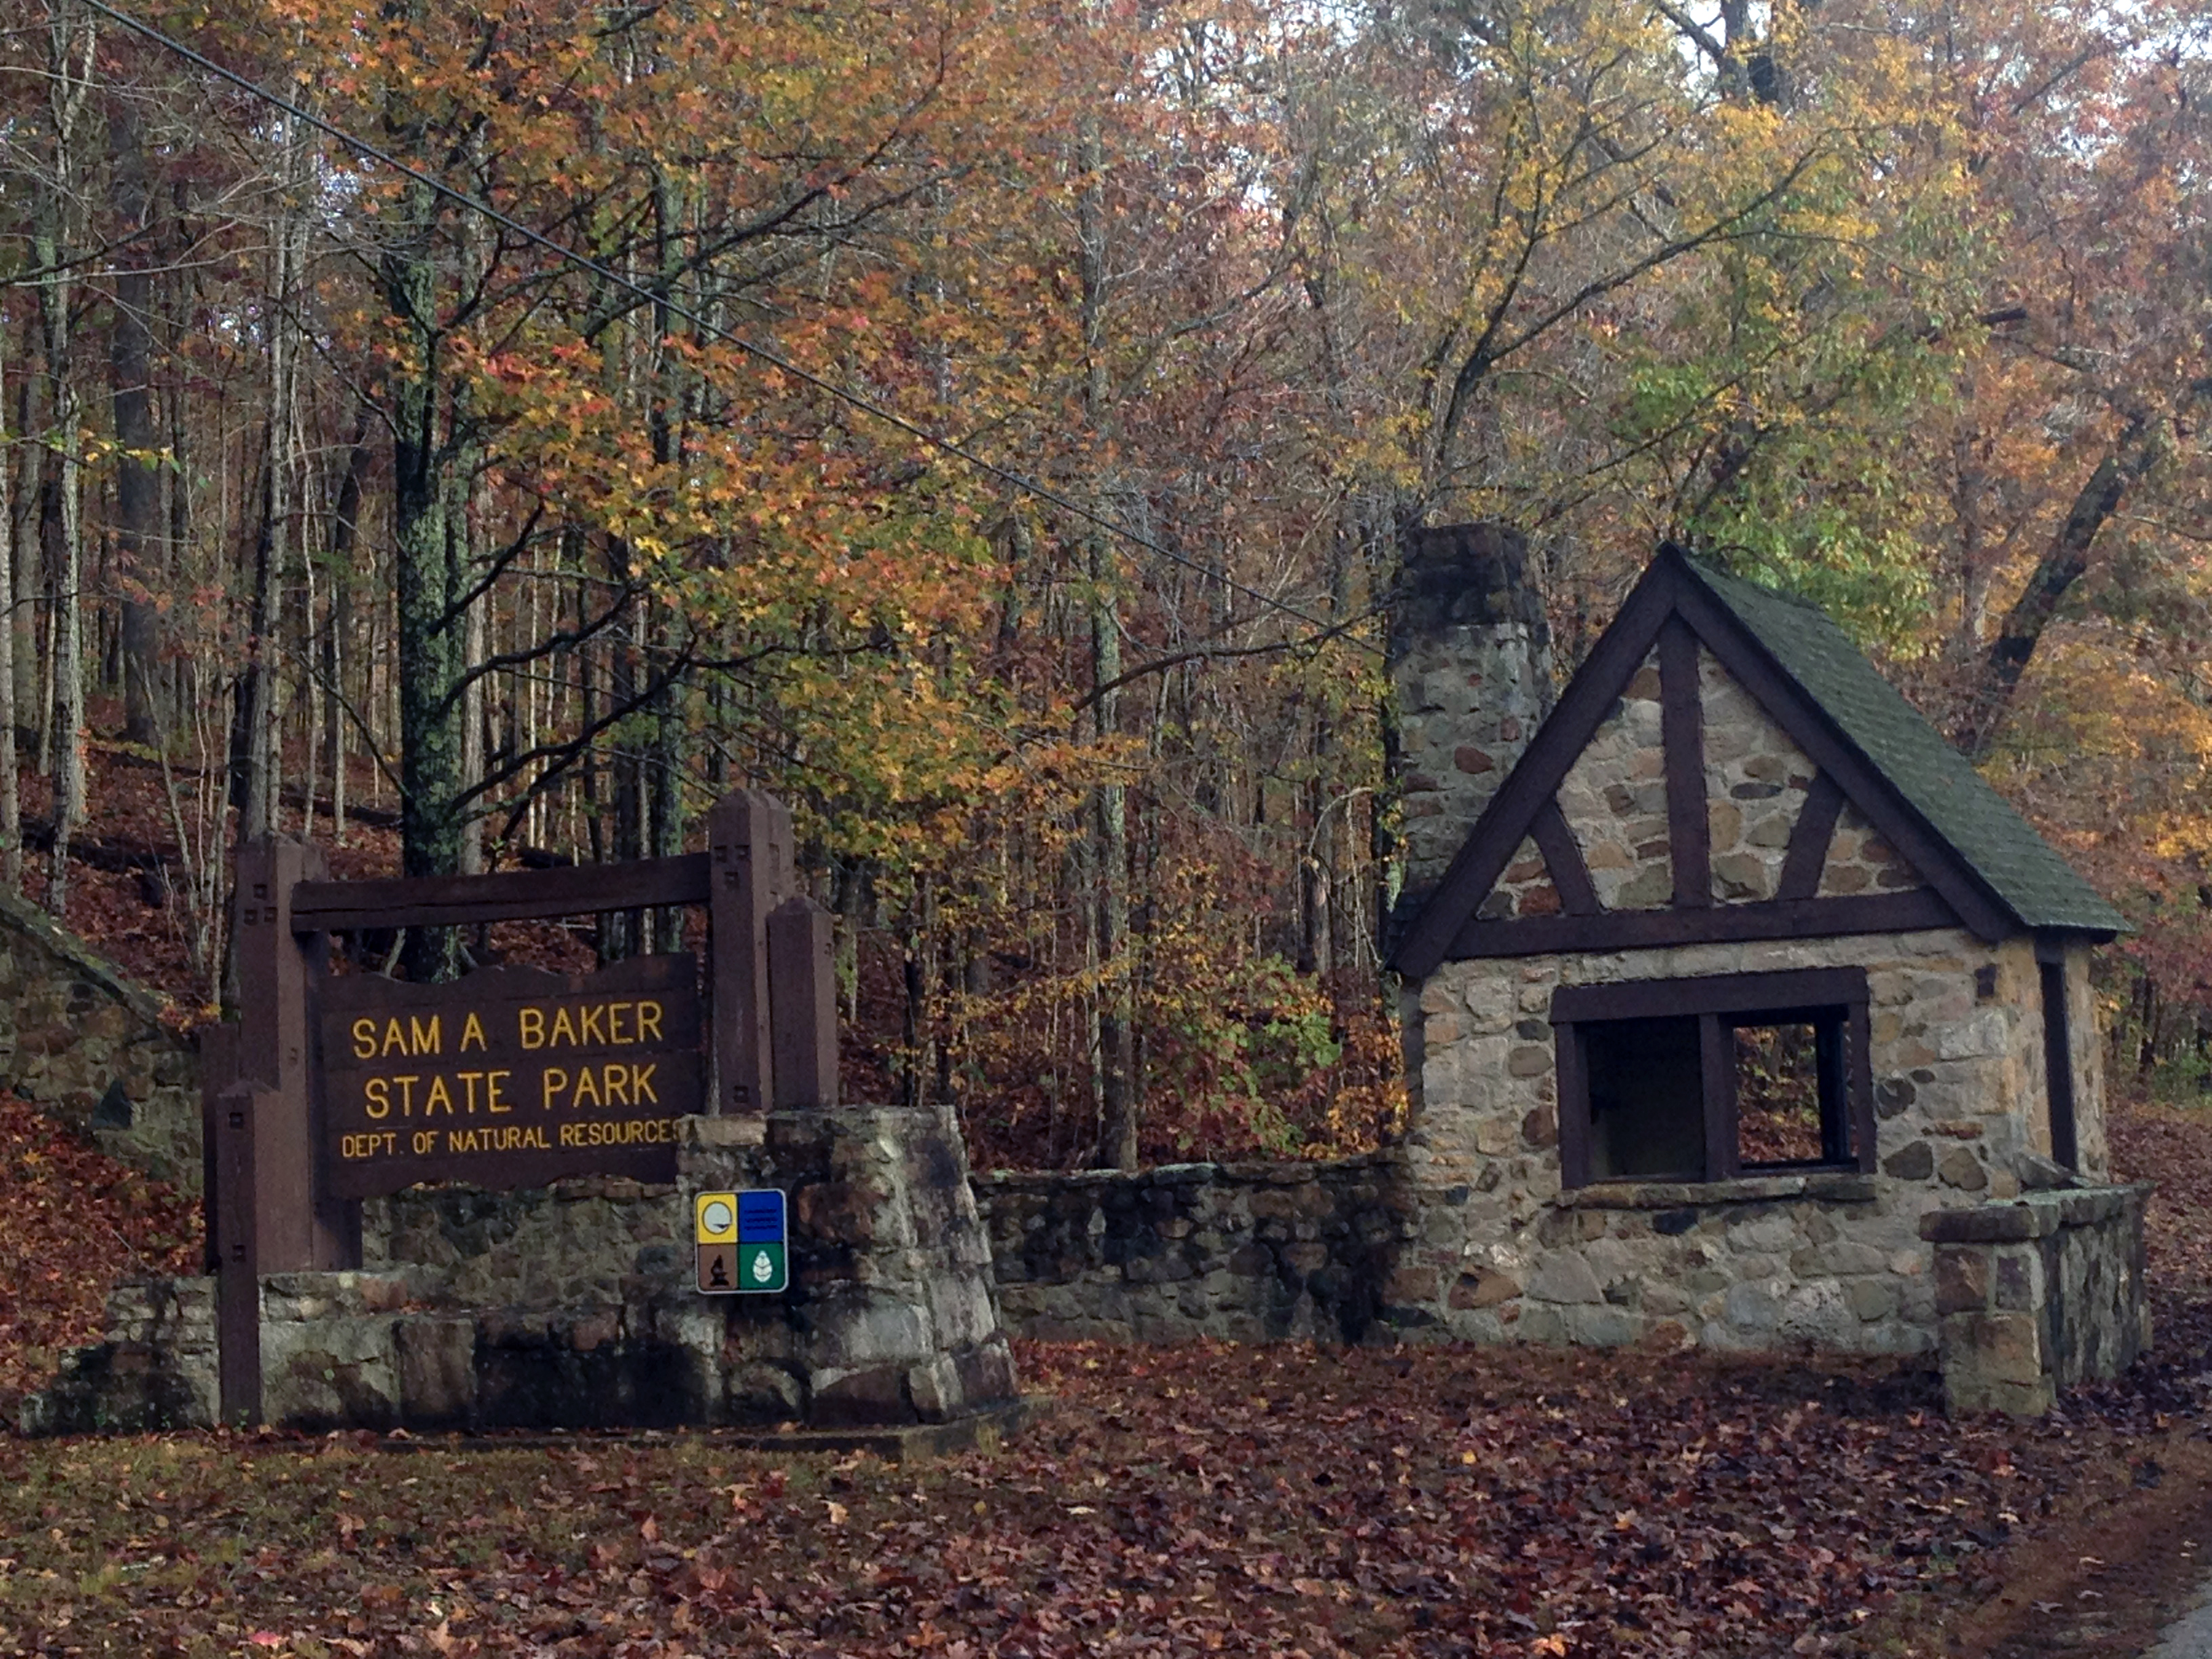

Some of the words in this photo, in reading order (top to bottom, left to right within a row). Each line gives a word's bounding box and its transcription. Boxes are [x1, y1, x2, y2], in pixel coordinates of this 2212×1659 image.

[352, 1015, 440, 1059] SAM
[460, 1012, 487, 1052] A
[520, 1000, 663, 1049] BAKER
[365, 1070, 511, 1119] STATE
[544, 1063, 658, 1110] PARK
[342, 1132, 403, 1158] DEPT.
[413, 1130, 438, 1155] OF
[450, 1125, 552, 1152] NATURAL
